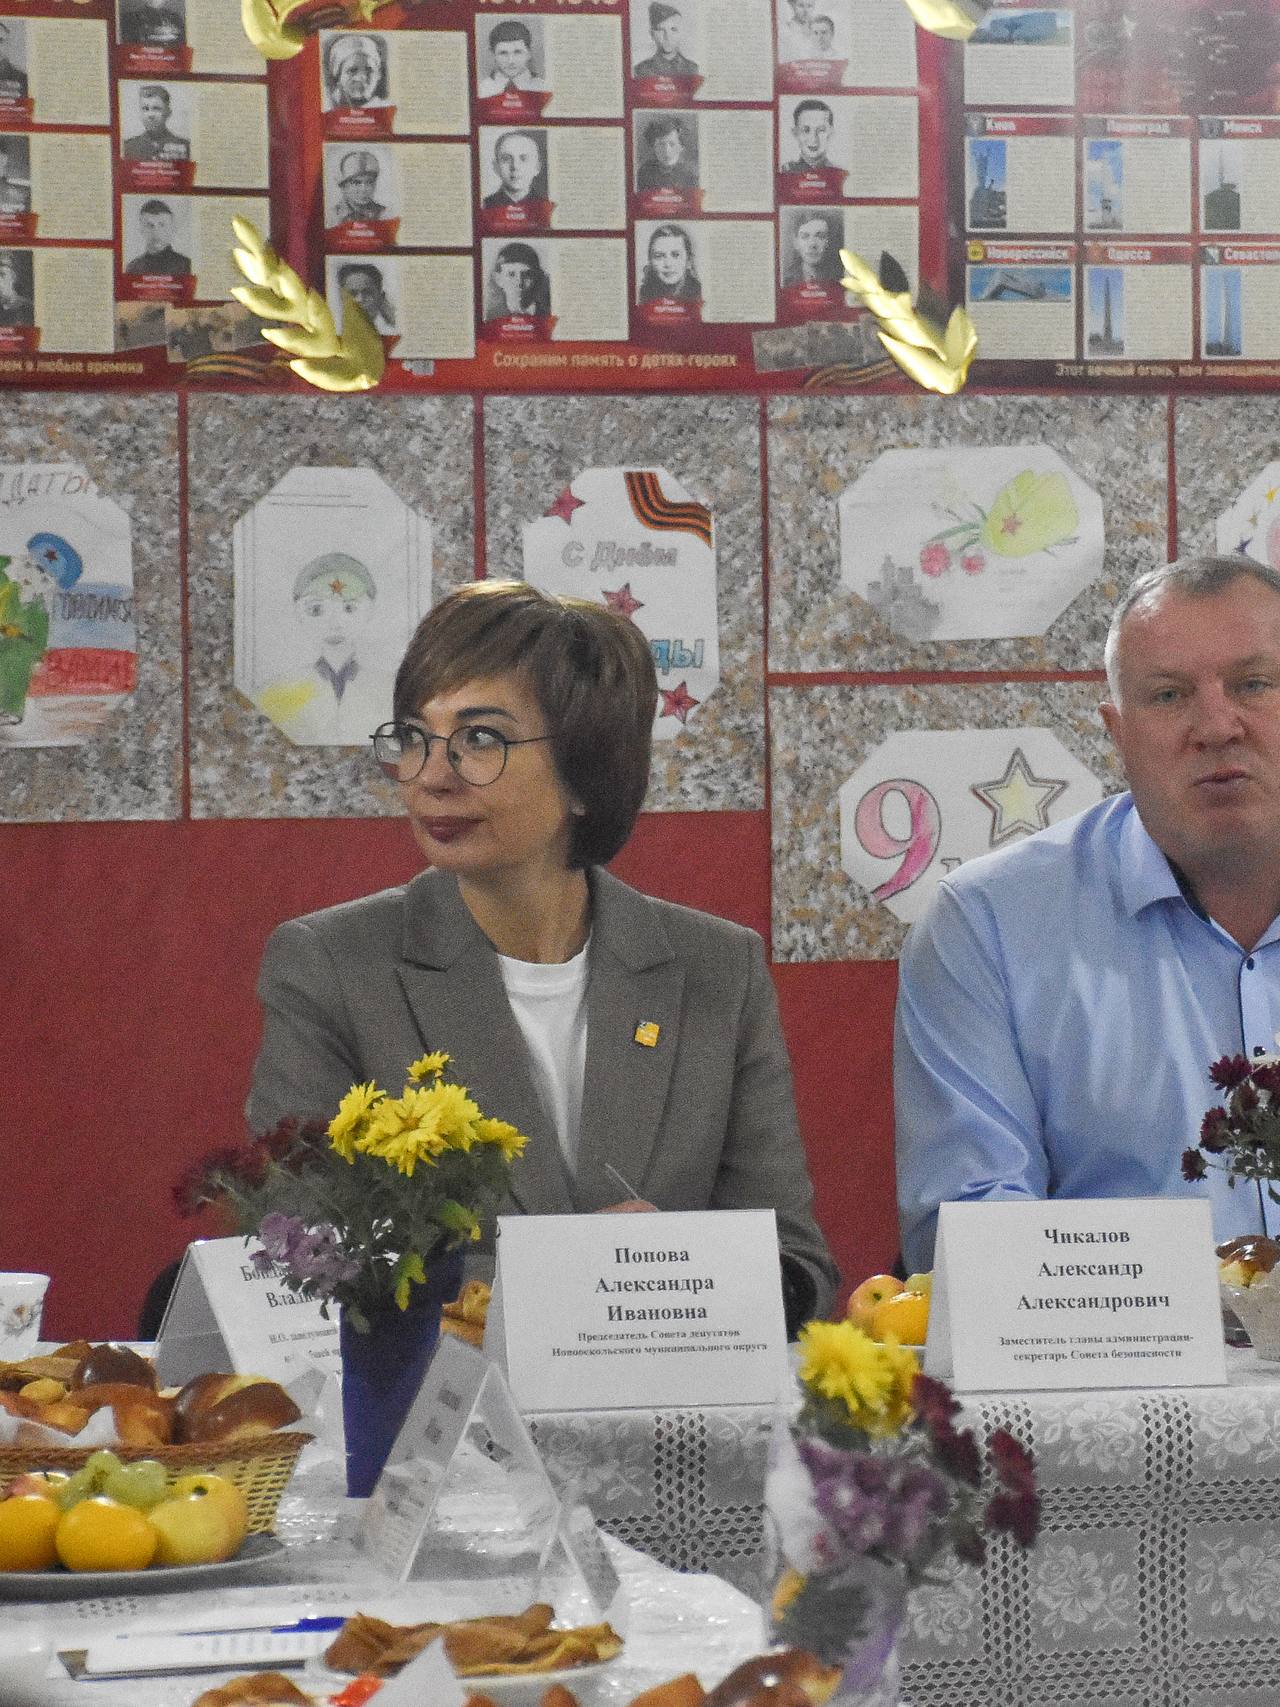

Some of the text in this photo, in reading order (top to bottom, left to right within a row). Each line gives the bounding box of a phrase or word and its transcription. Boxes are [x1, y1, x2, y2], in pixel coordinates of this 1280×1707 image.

[493, 352, 568, 368] Сохраним
[571, 354, 624, 368] память
[627, 355, 638, 368] о
[561, 541, 585, 568] С
[854, 778, 942, 901] 9
[1044, 1228, 1130, 1244] Чикалов
[614, 1247, 690, 1264] Попова
[1037, 1261, 1143, 1279] Александр
[595, 1275, 715, 1294] Александра
[1016, 1294, 1170, 1312] Александрович
[607, 1304, 708, 1321] Ивановна
[577, 1329, 741, 1343] Председатель Совета депутатов
[1000, 1335, 1066, 1346] Заместитель
[1069, 1335, 1103, 1345] главы
[551, 1342, 768, 1357] Новооскольского муниципального округа
[1013, 1348, 1182, 1362] секретарь Совета безопасности
